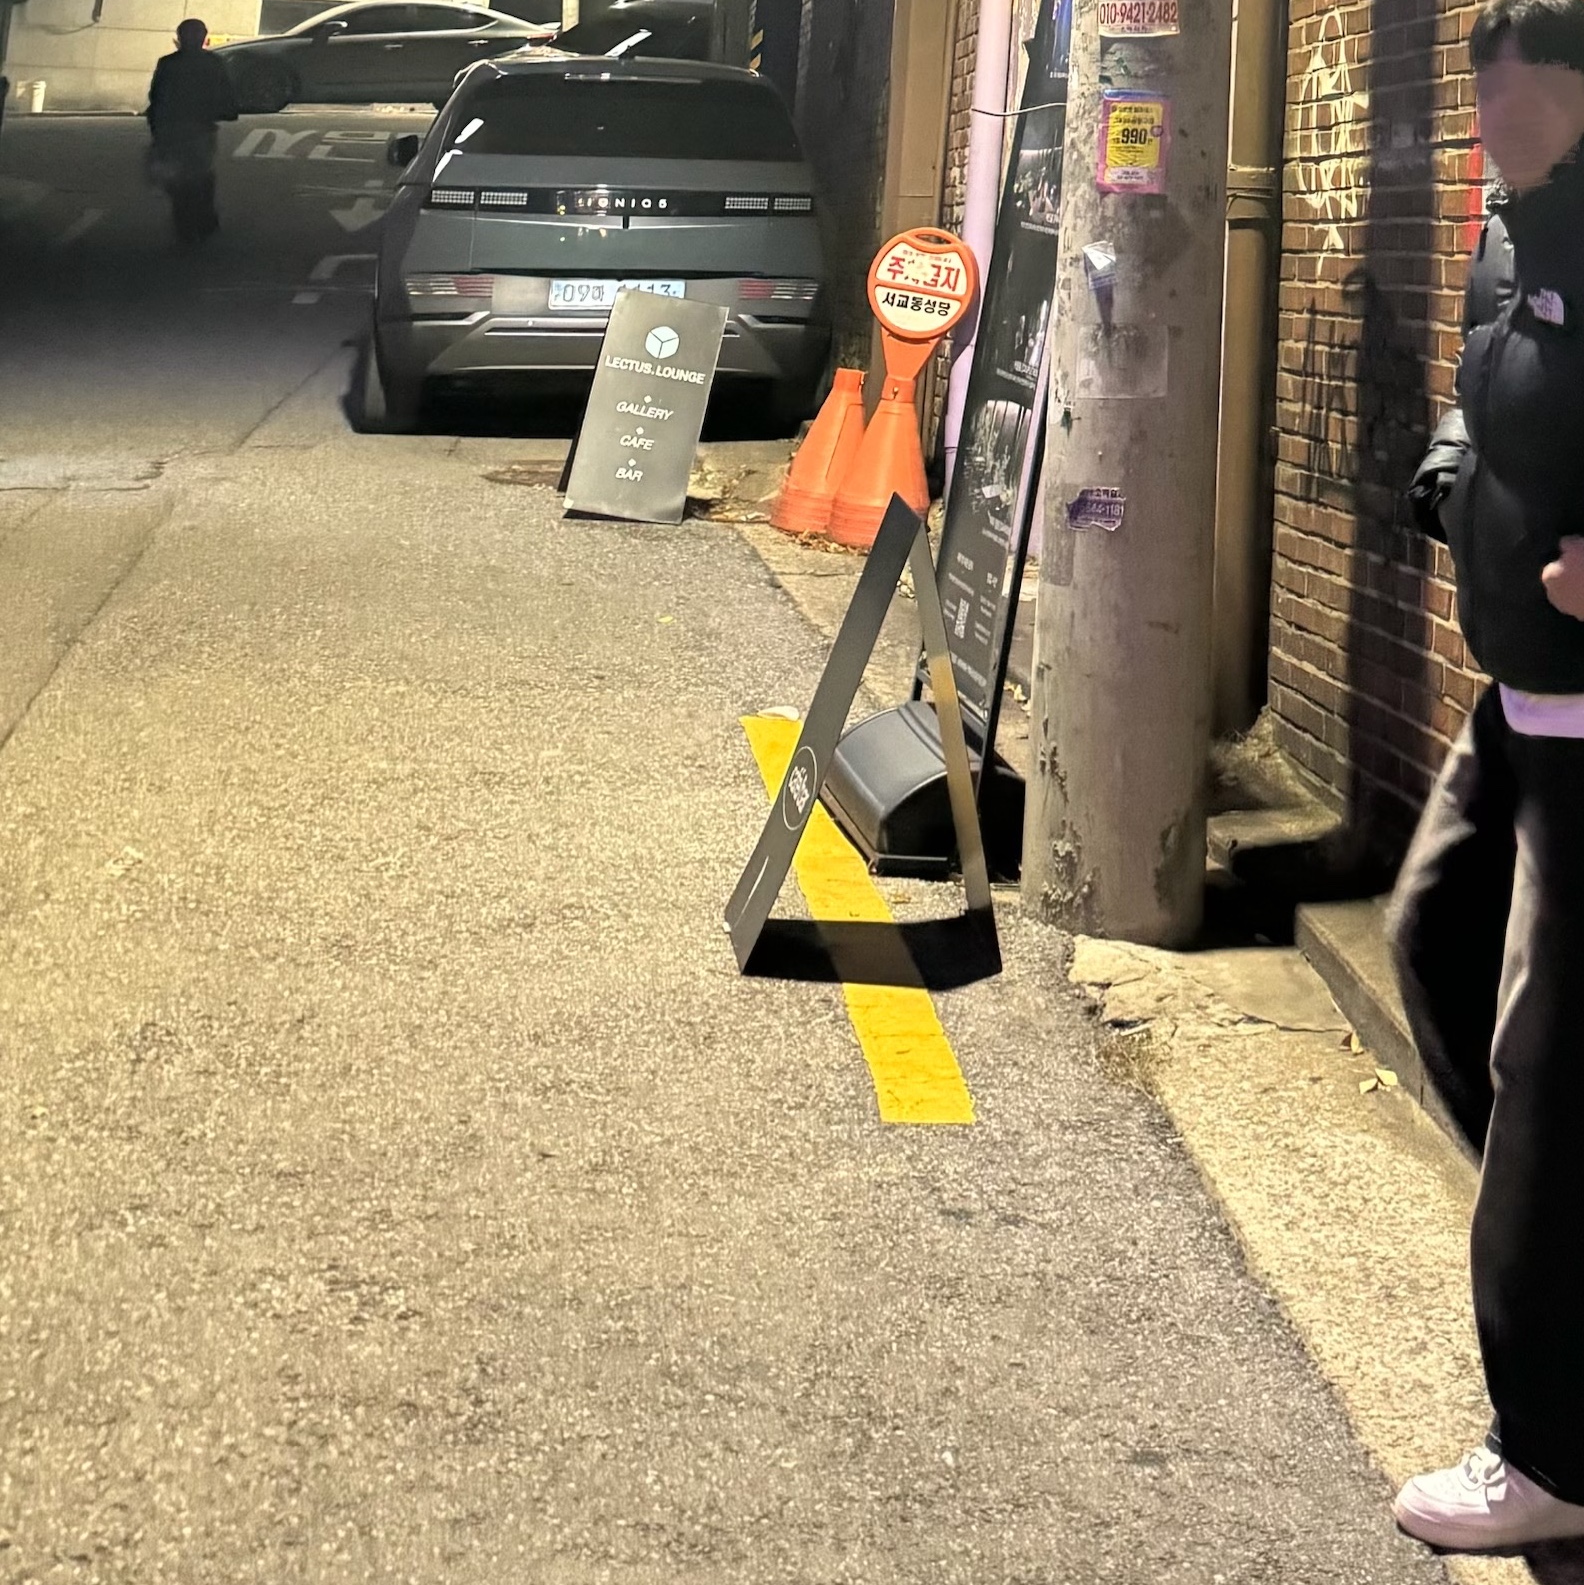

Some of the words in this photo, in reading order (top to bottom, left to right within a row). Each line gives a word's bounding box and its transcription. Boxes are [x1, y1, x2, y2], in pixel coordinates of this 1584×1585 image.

[887, 256, 961, 292] 주금지
[882, 292, 951, 317] 서교동성당
[616, 401, 674, 421] GALLERY
[619, 434, 655, 451] CAFE
[615, 467, 644, 482] BAR
